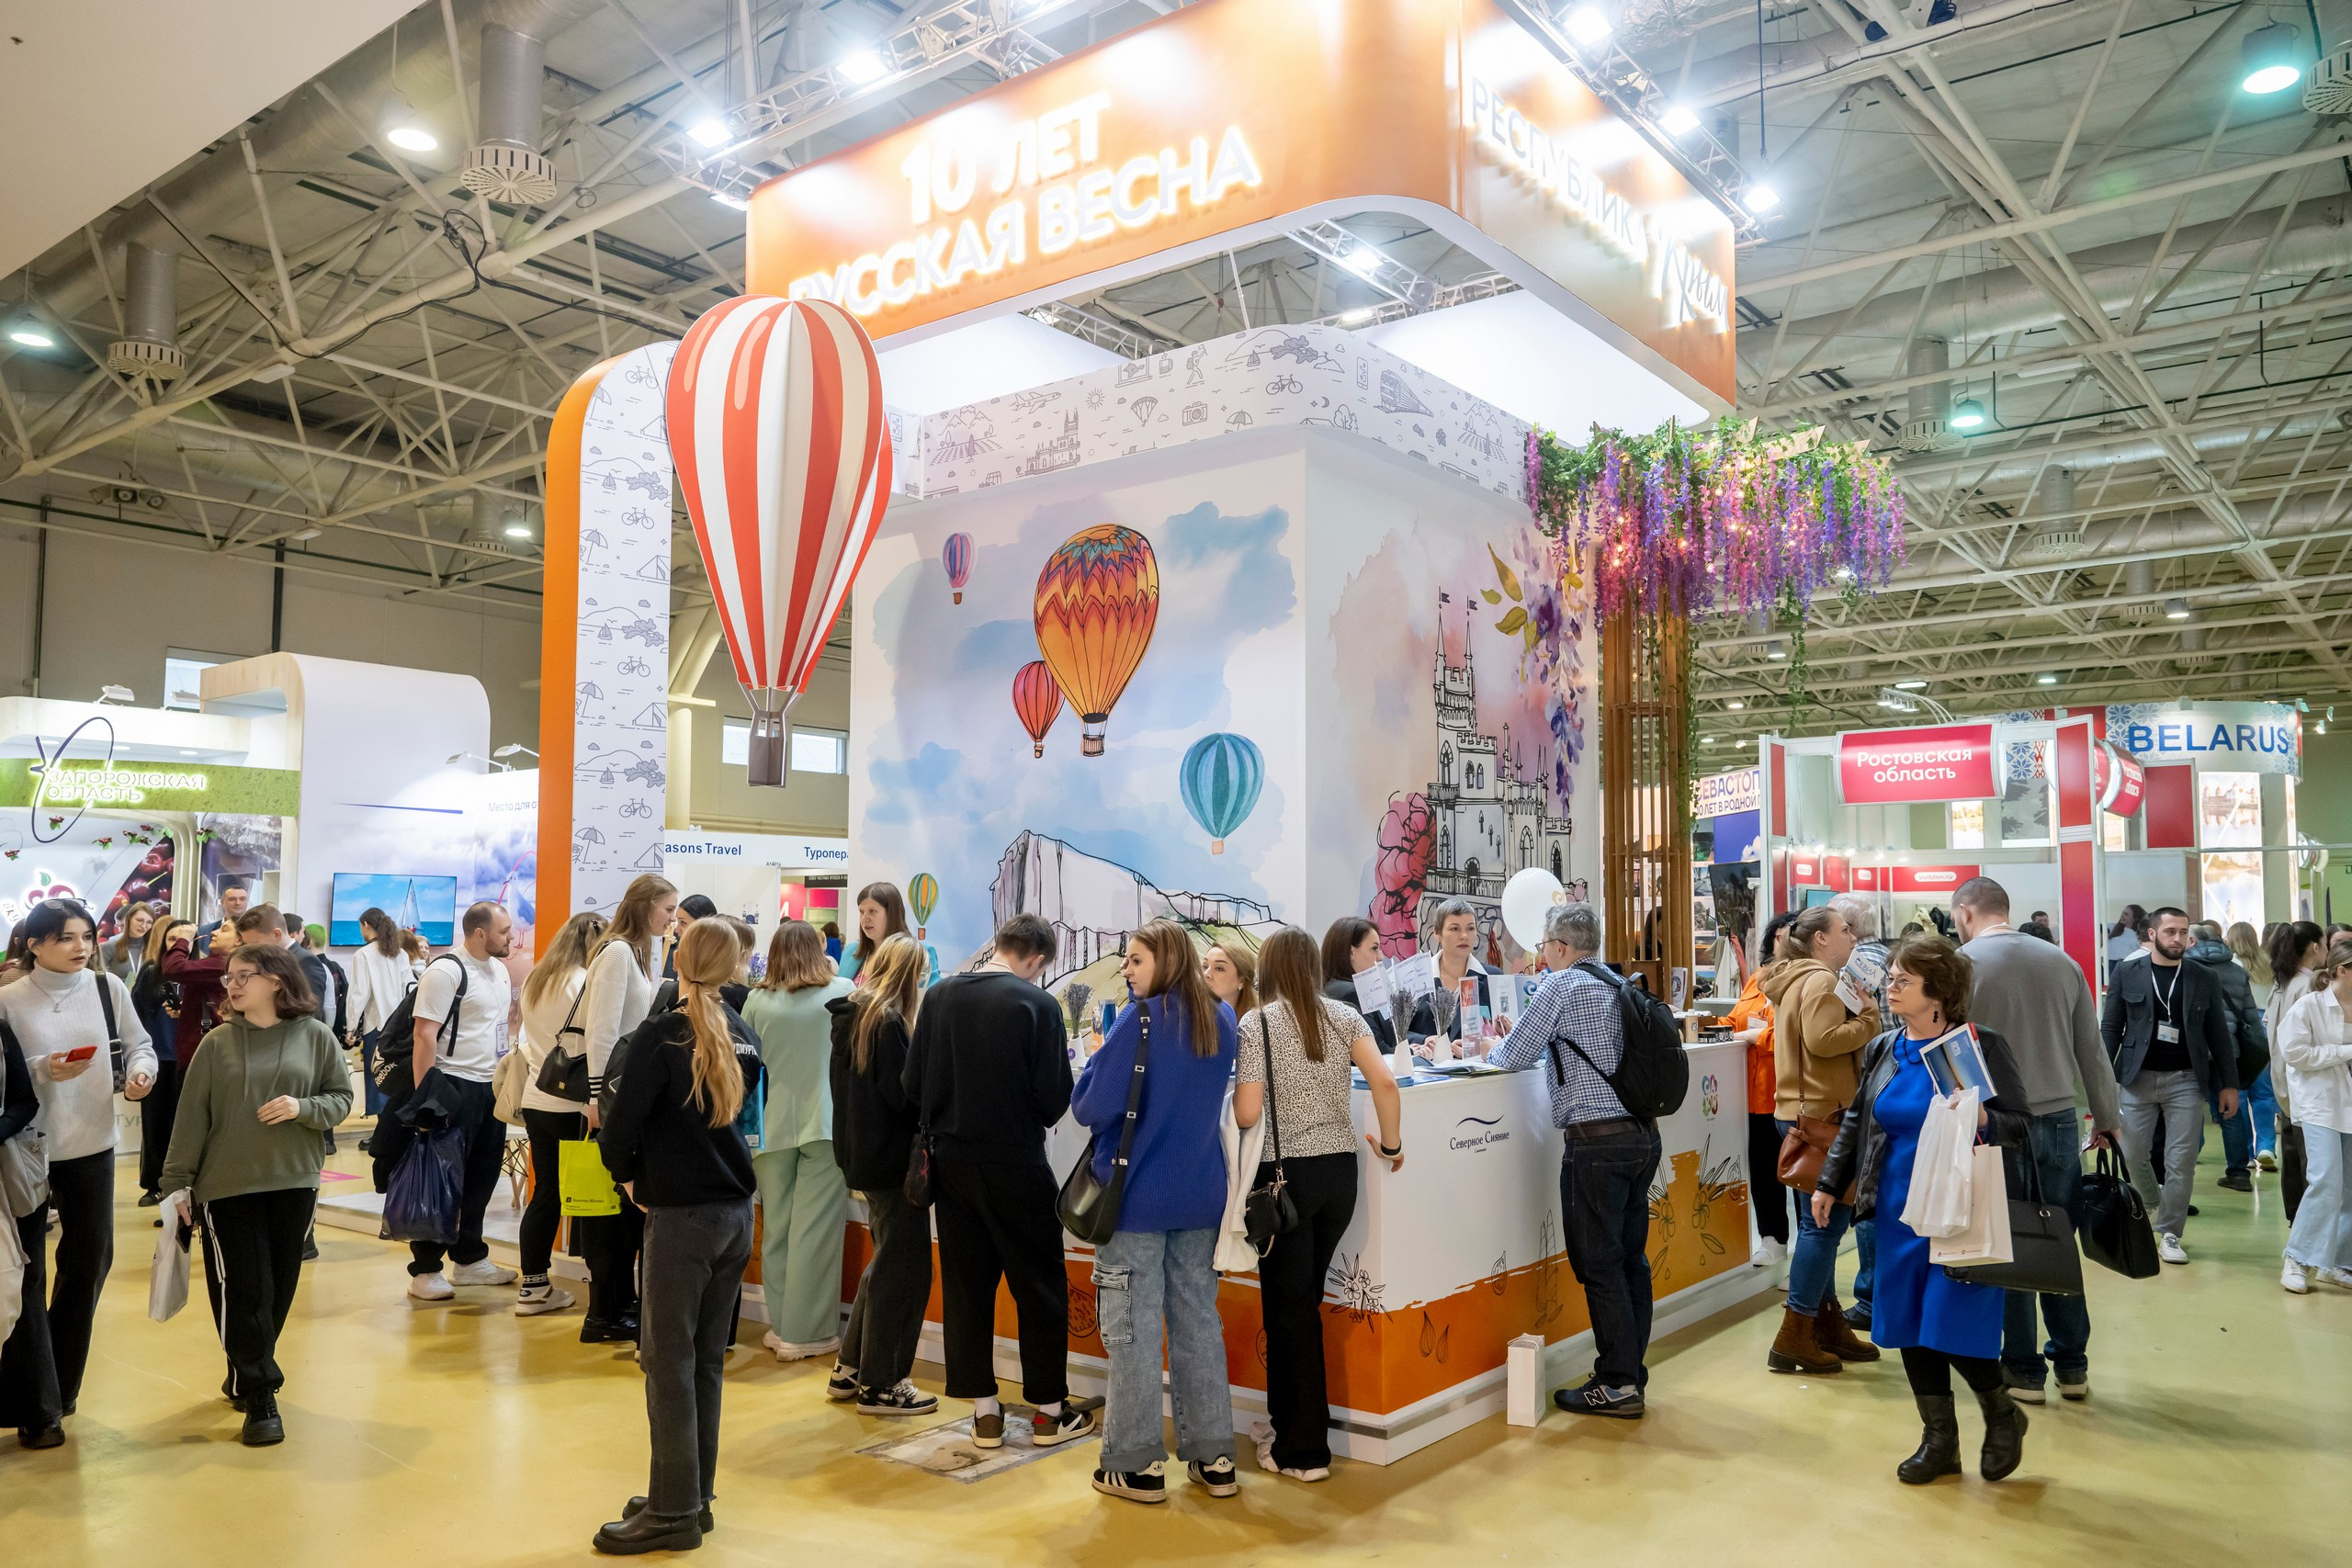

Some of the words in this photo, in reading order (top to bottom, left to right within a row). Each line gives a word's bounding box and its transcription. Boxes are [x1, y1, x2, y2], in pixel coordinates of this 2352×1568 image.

[900, 143, 978, 224] 10
[992, 92, 1110, 191] ЛЕТ
[1038, 125, 1261, 254] ВЕСНА
[2128, 723, 2290, 754] BELARUS
[1857, 749, 1973, 768] Ростовская
[47, 770, 205, 789] ЗАПОРОЖСКАЯ
[1873, 766, 1957, 783] область
[47, 785, 141, 801] ОБЛАСТЬ
[488, 802, 514, 812] Место
[514, 801, 530, 811] для
[1704, 802, 1717, 815] ЛЕТ
[1718, 801, 1724, 813] В
[1724, 792, 1757, 811] РОДНОЙ
[705, 842, 742, 856] Travel
[374, 1062, 399, 1088] Reebok
[1449, 1136, 1484, 1150] Северное
[1485, 1130, 1510, 1144] Сияние
